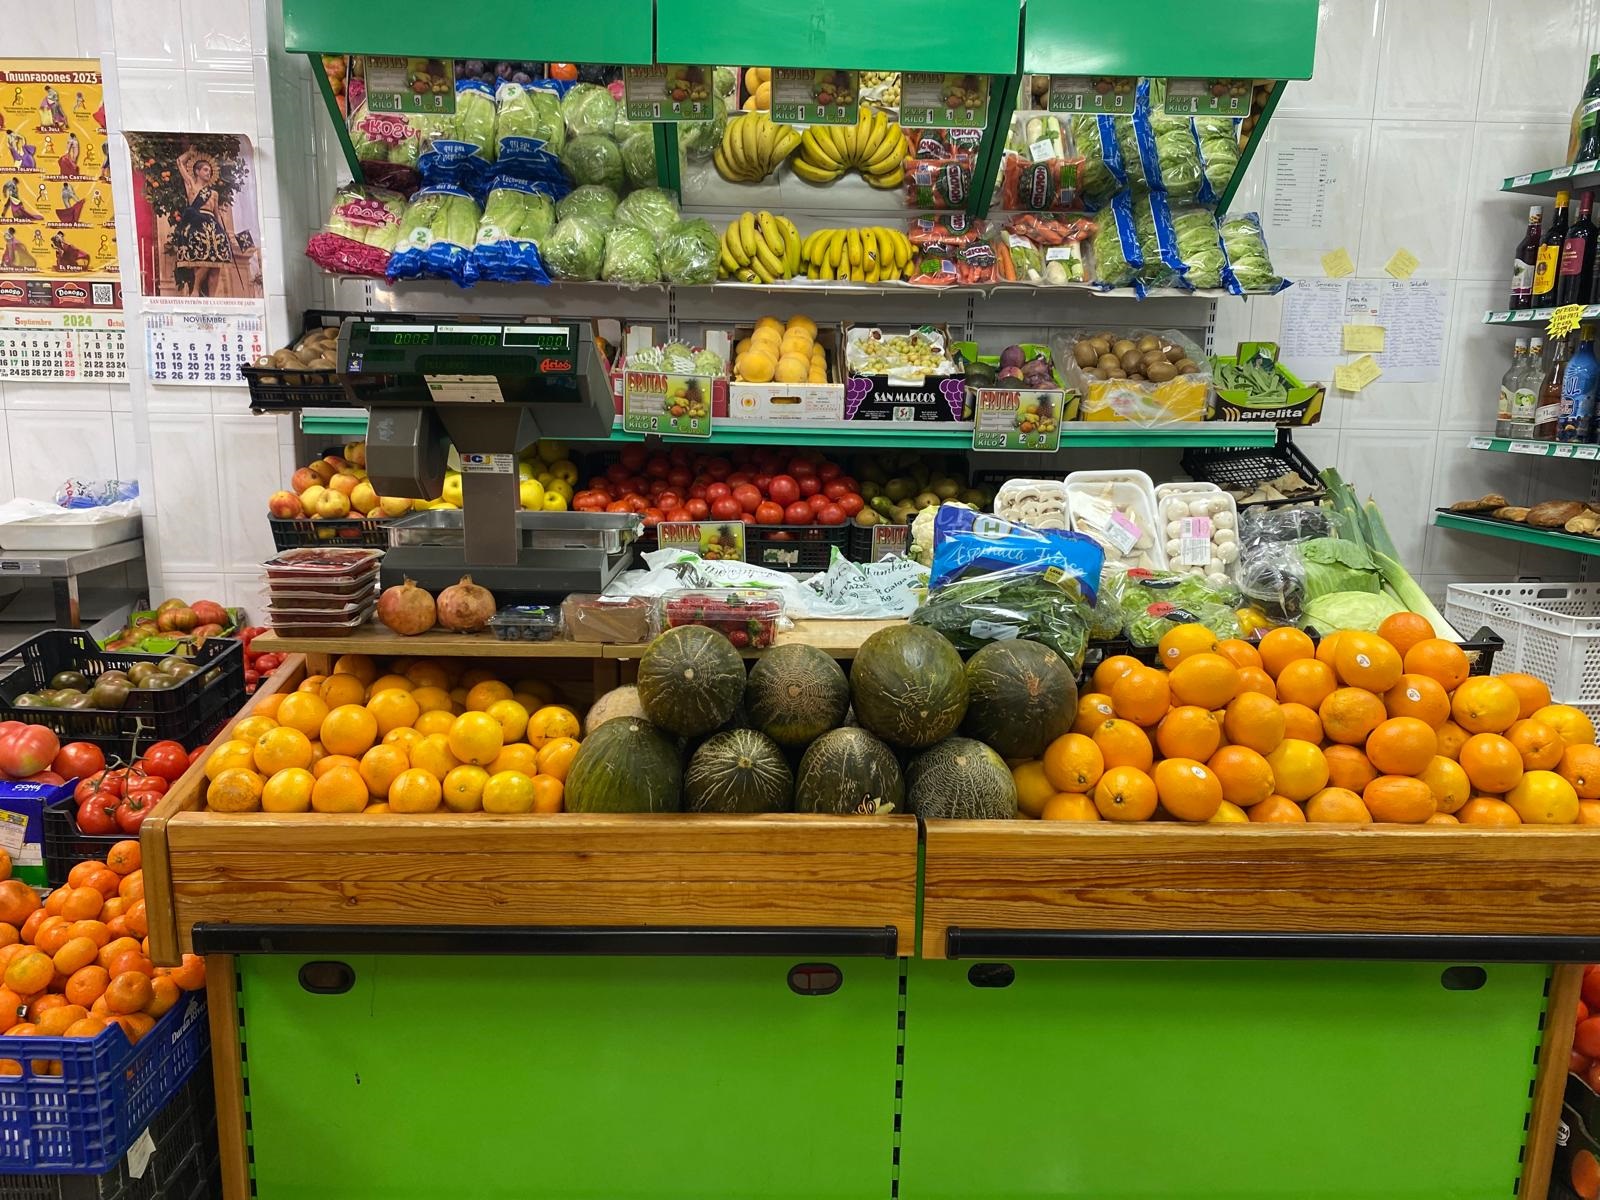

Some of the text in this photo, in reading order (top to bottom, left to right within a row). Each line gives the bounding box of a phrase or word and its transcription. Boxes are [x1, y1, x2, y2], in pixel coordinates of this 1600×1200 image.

[72, 73, 97, 84] 2023
[62, 314, 93, 327] 2024
[184, 316, 226, 324] NOVIEMBRE
[222, 334, 227, 342] 1
[189, 343, 196, 351] 6
[222, 344, 228, 352] 8
[155, 352, 164, 360] 11
[188, 353, 198, 361] 13
[236, 354, 246, 362] 16
[155, 362, 166, 370] 18
[172, 362, 182, 370] 19
[204, 363, 214, 371] 21
[220, 363, 231, 371] 22
[42, 369, 52, 377] 27
[155, 371, 166, 379] 25
[171, 372, 183, 380] 26
[188, 372, 199, 380] 27
[204, 372, 215, 380] 28
[627, 373, 668, 393] FRUTAS
[874, 392, 936, 402] SAN MARCOS
[980, 392, 1021, 411] FRUTAS
[651, 418, 657, 428] 2
[999, 435, 1005, 446] 2
[984, 522, 1000, 532] H
[662, 524, 702, 542] FRUTAS
